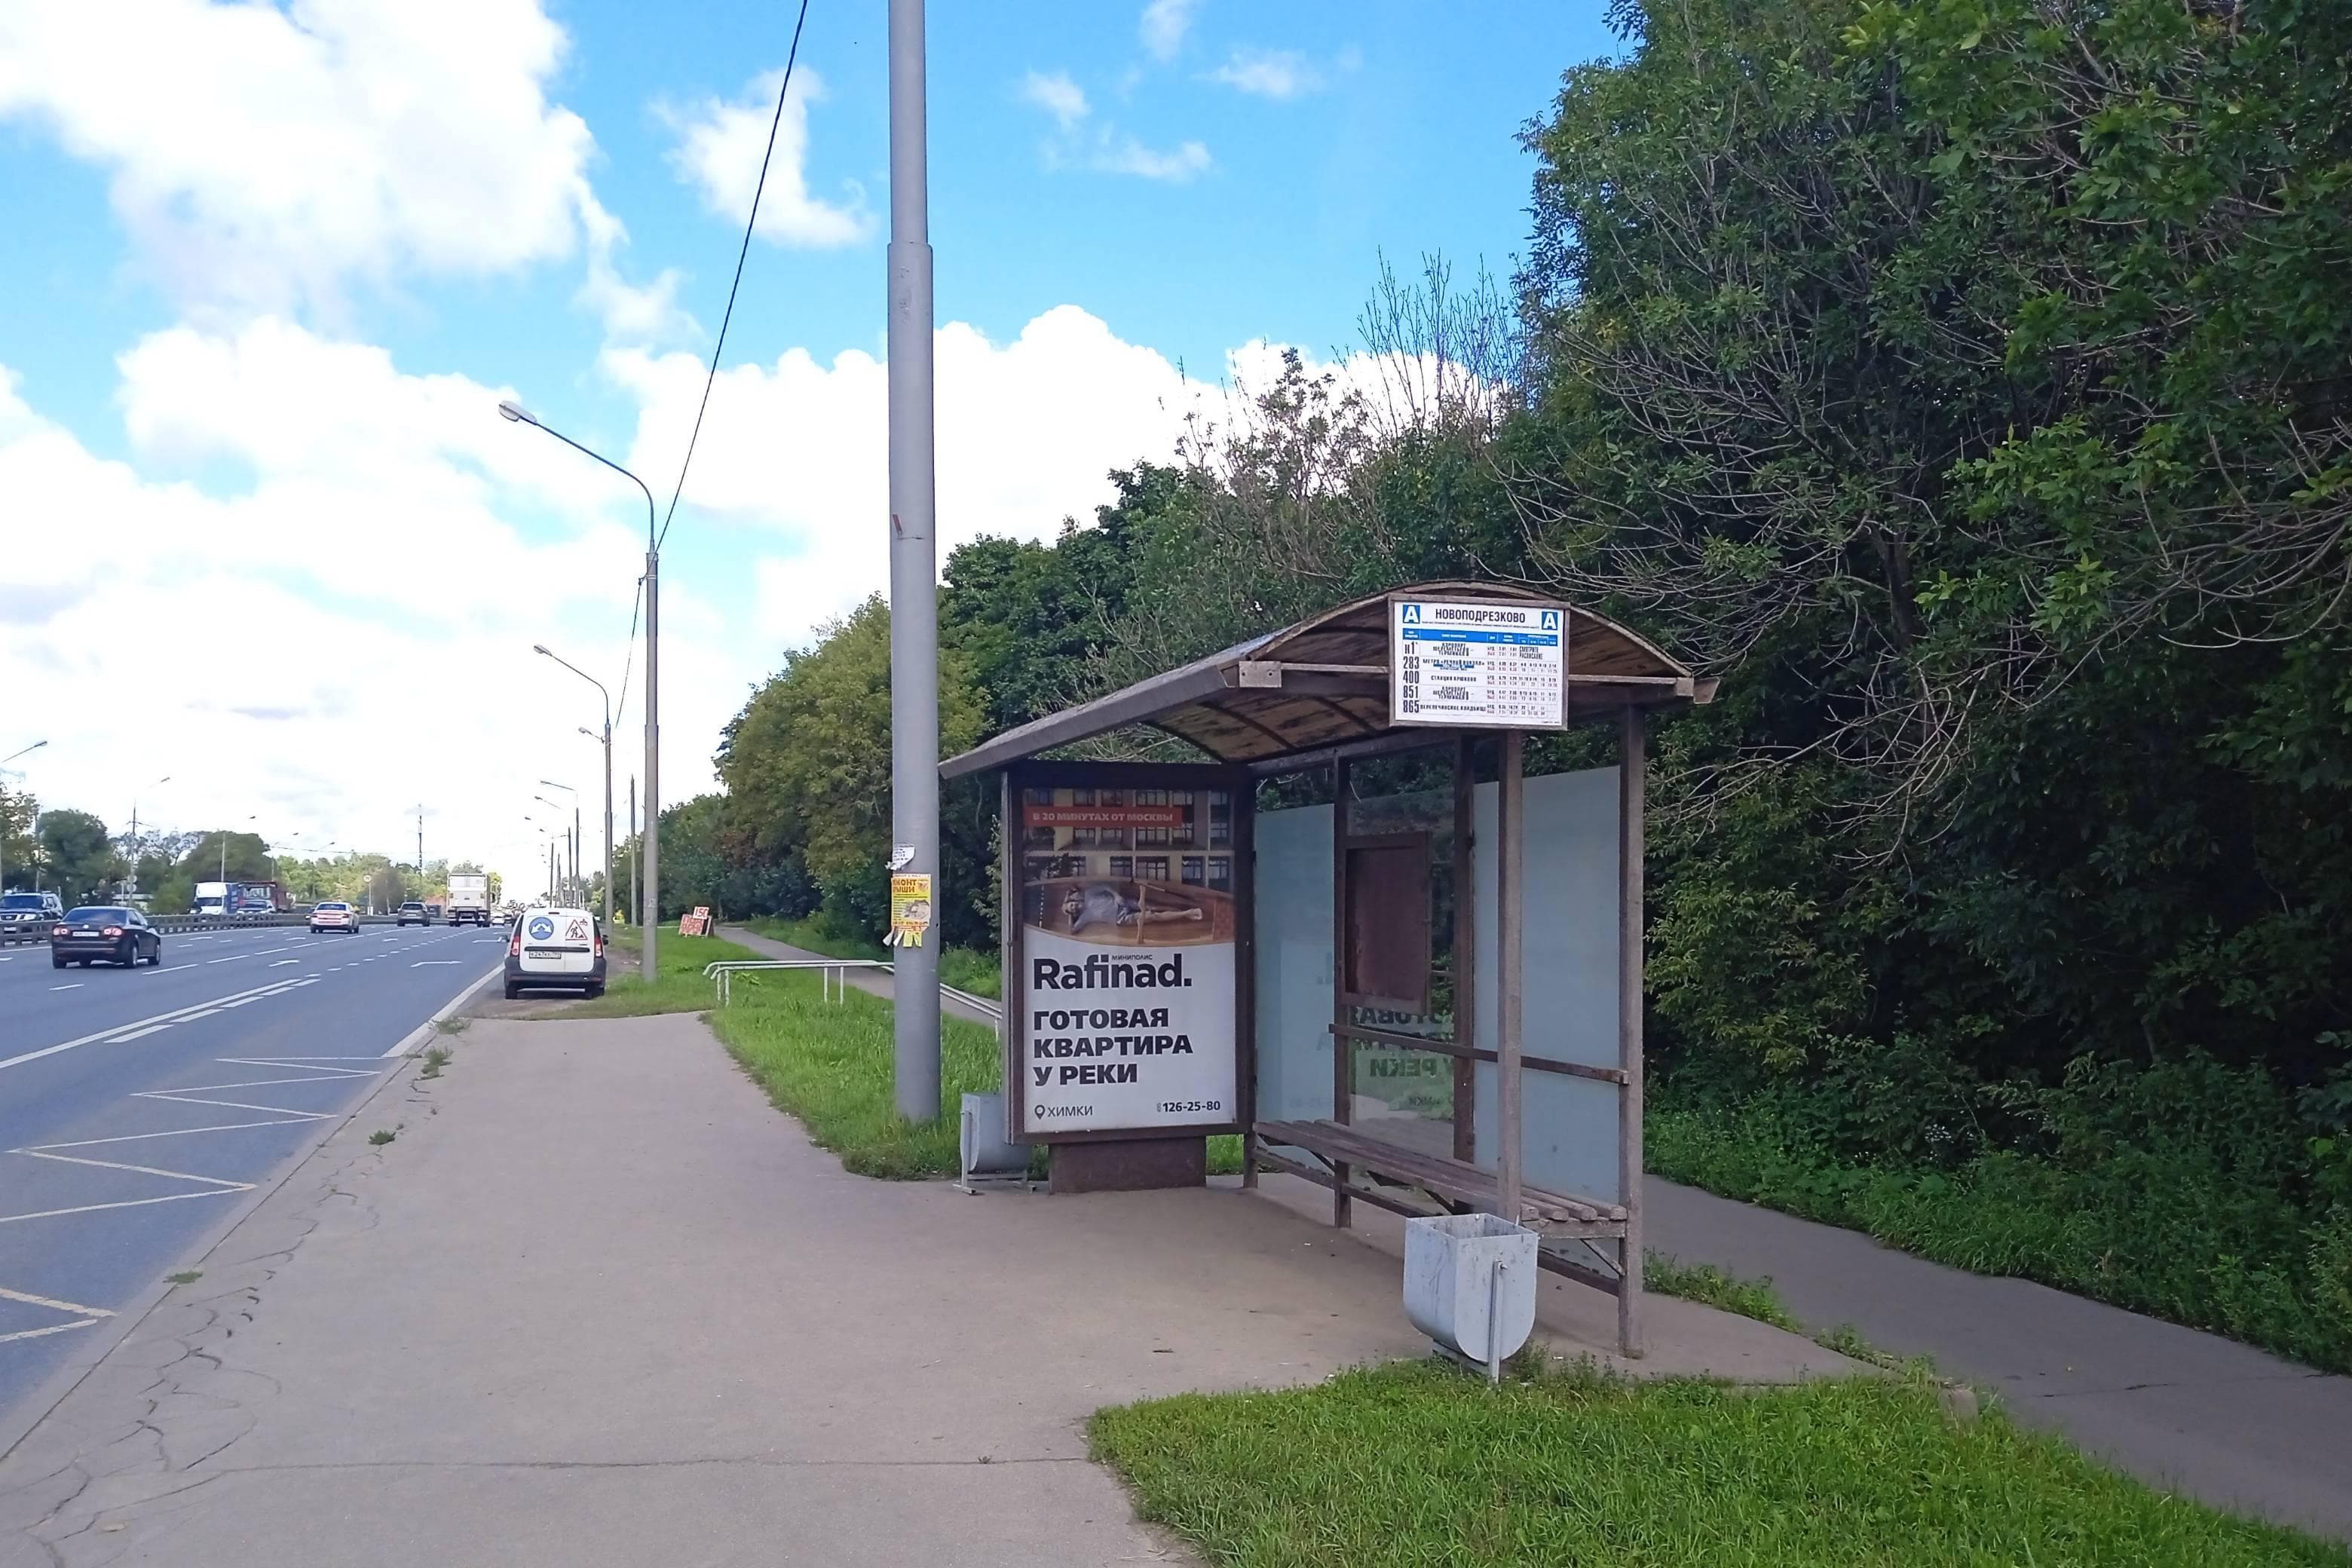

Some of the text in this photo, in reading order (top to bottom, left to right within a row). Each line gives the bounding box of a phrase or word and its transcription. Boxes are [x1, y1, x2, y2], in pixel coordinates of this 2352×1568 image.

[1435, 608, 1526, 623] НОВОПОДРЕЗКОВО
[1403, 656, 1419, 669] 283
[1403, 670, 1419, 684] 400
[1403, 685, 1419, 698] 851
[1403, 700, 1420, 713] 865
[1057, 813, 1110, 821] МИНУТАХ
[1111, 813, 1124, 821] ОТ
[1034, 953, 1192, 990] Rafinad.
[1034, 1008, 1168, 1031] ГОТОВАЯ
[1034, 1034, 1193, 1058] КВАРТИРА
[1033, 1063, 1138, 1086] У РЕКИ
[1048, 1105, 1093, 1117] ХИМКИ
[1162, 1101, 1221, 1112] 126-25-80
